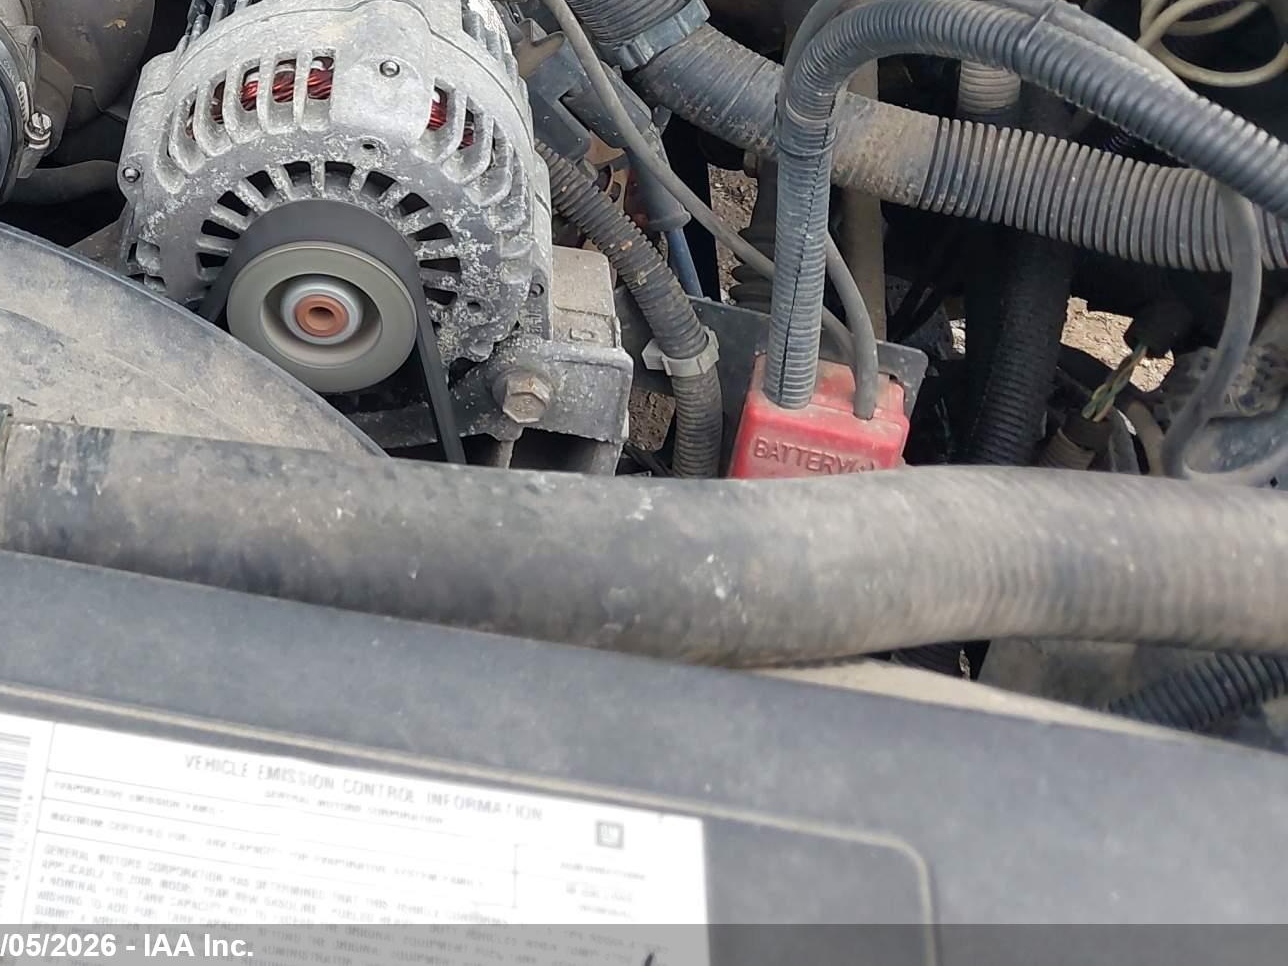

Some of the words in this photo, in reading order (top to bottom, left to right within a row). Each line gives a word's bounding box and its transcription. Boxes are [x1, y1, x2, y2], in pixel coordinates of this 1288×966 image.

[183, 754, 249, 778] VEHICLE
[257, 763, 335, 791] EMISSION
[343, 777, 416, 804] CONTROL
[426, 791, 544, 822] INFORMATION
